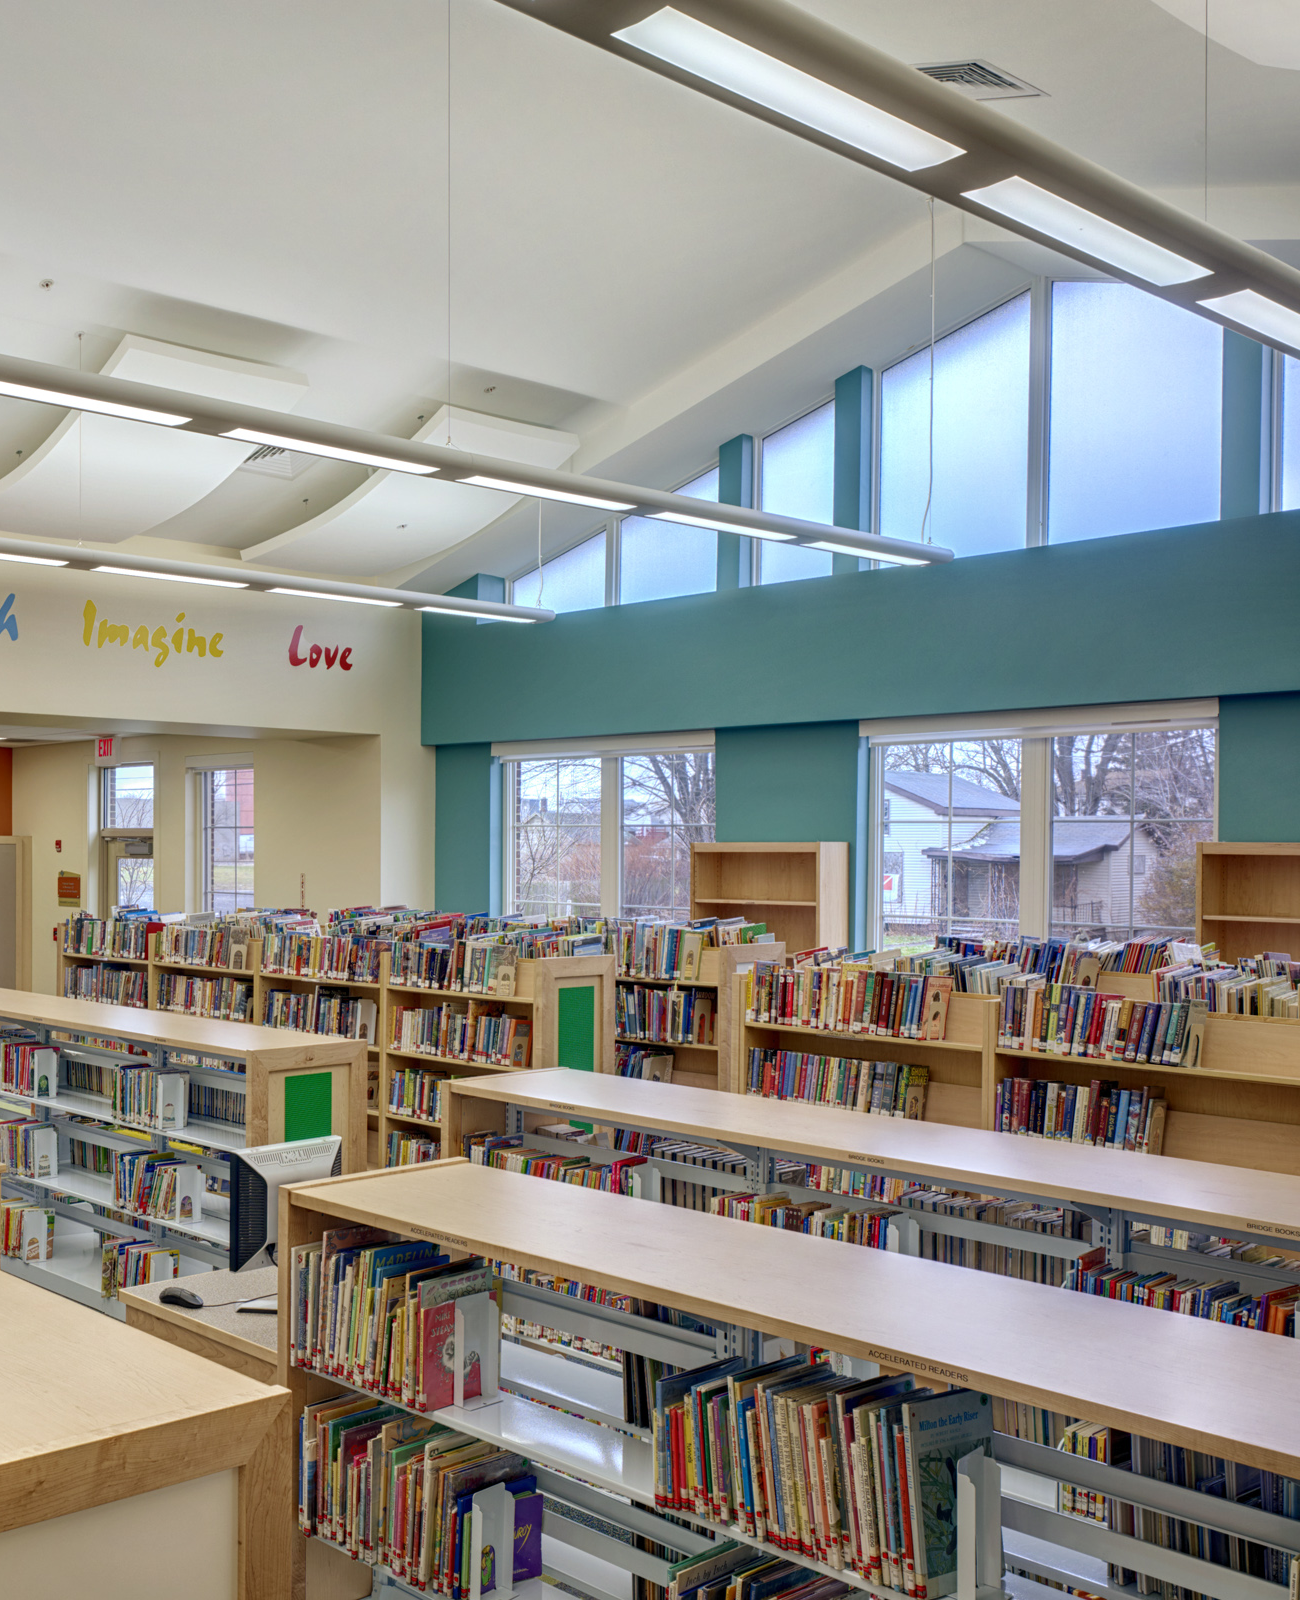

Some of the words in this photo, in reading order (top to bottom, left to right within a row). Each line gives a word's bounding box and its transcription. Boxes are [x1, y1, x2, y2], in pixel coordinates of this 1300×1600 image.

[82, 599, 226, 668] Imagine
[287, 624, 355, 671] Love
[98, 738, 113, 757] EXIT
[867, 1157, 884, 1165] BOOKS
[410, 1227, 444, 1241] ACCELERATED
[444, 1235, 468, 1248] READERS
[1246, 1222, 1273, 1233] BRIDGE
[1275, 1227, 1300, 1237] BOOKS
[868, 1350, 927, 1371] ACCELERATED
[928, 1365, 969, 1383] READERS
[919, 1420, 937, 1432] Milton
[938, 1418, 948, 1427] the
[948, 1414, 963, 1426] Early
[964, 1411, 979, 1421] Riser
[784, 1450, 792, 1480] FRANCES
[685, 1576, 700, 1588] Inch
[702, 1570, 712, 1580] by
[713, 1561, 728, 1575] Inch
